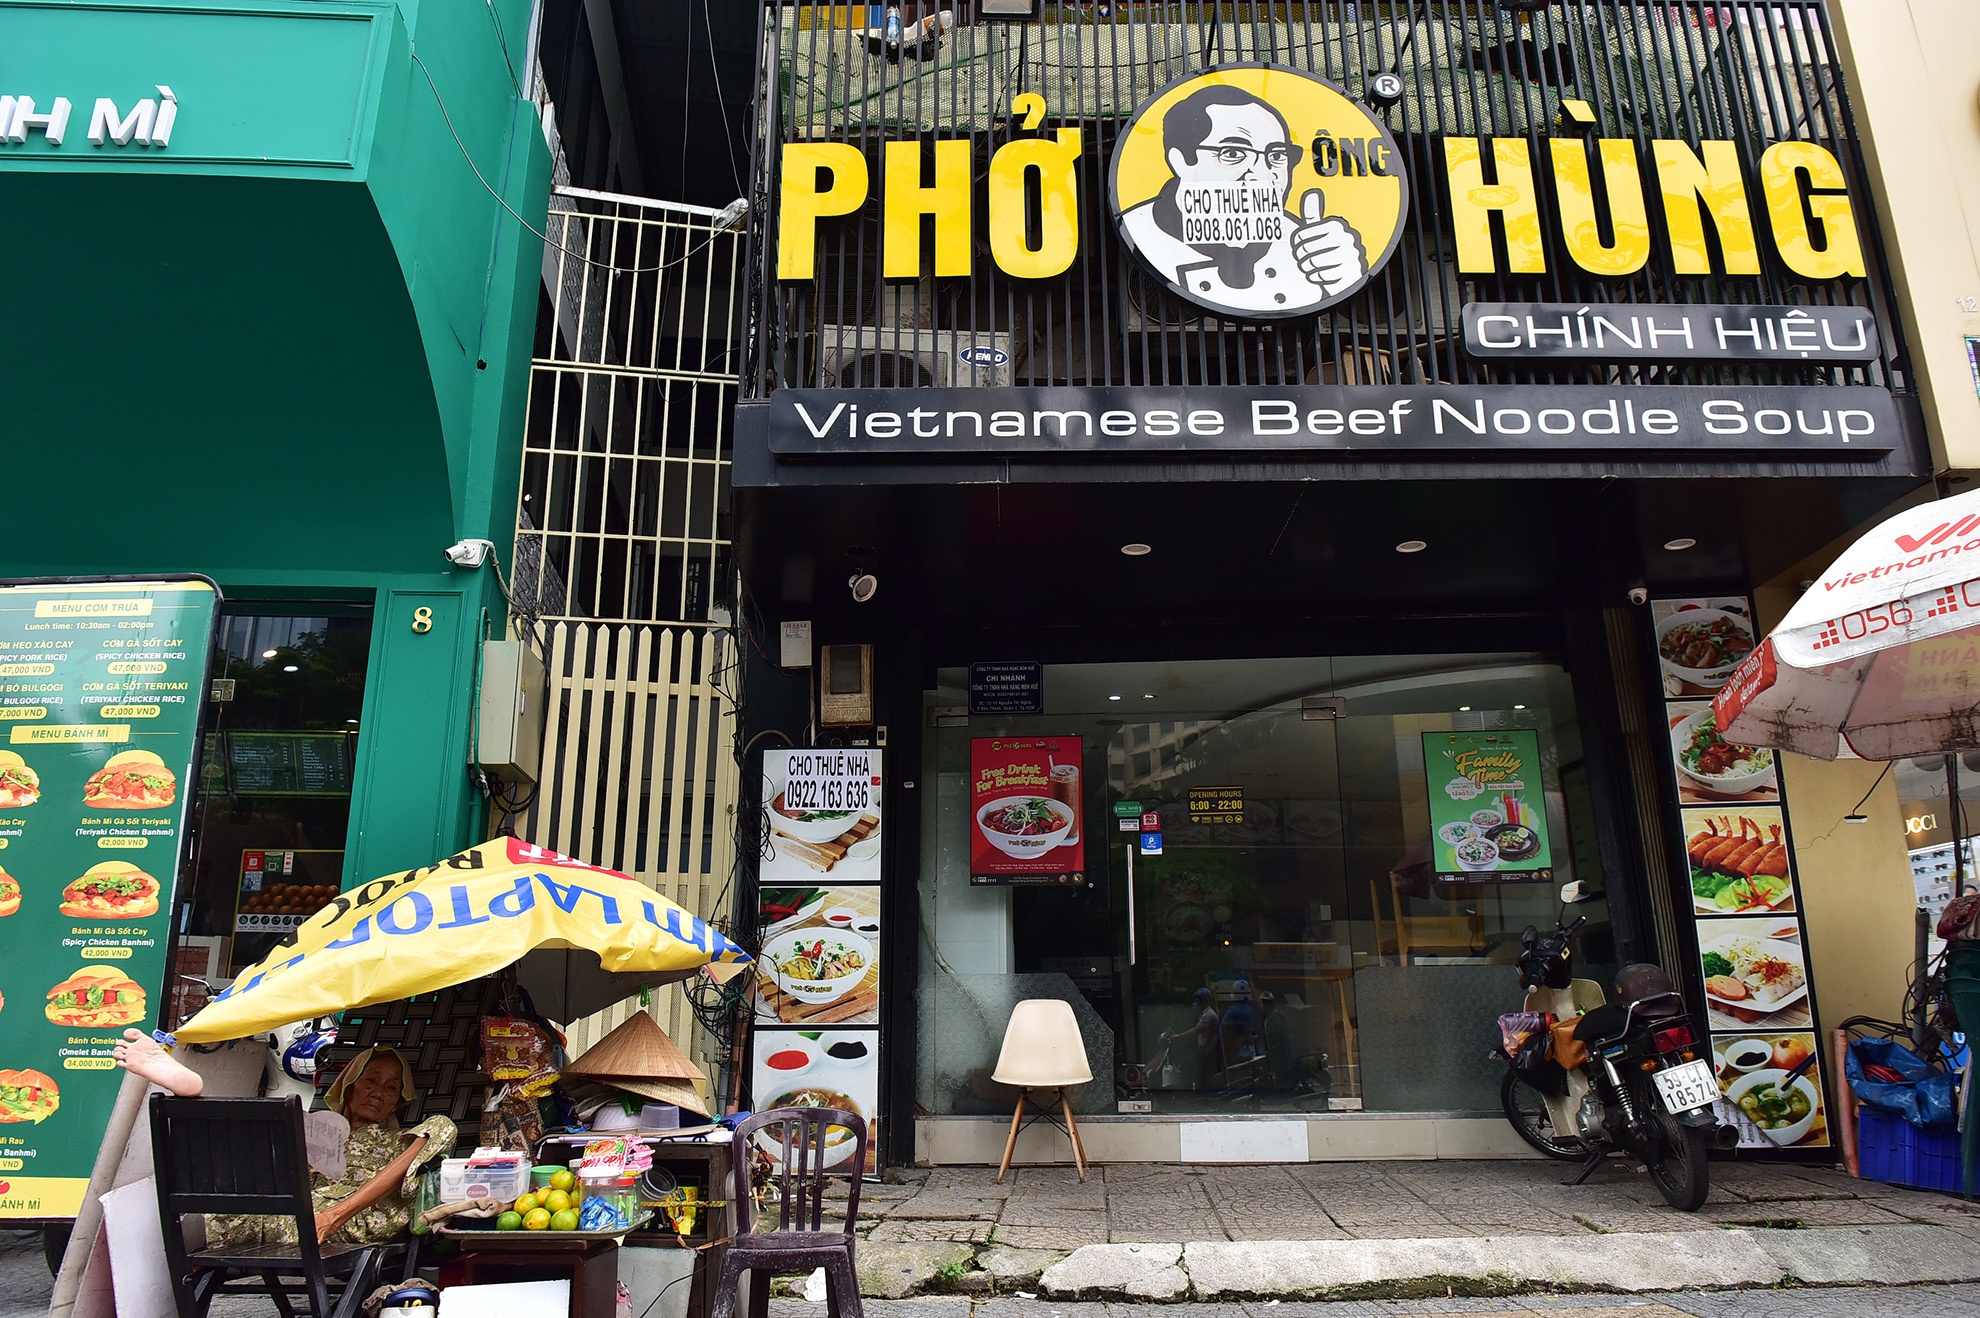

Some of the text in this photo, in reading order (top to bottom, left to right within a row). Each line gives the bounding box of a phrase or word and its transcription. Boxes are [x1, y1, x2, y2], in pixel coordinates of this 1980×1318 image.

[87, 84, 178, 147] MÌ
[777, 92, 1867, 279] PHỞ ÔNG HÙNG
[1184, 179, 1281, 214] CHO THUÊ NHÀ
[1185, 216, 1283, 242] 0908.061.068
[1478, 306, 1867, 358] CHÍNH HIỆU
[793, 399, 1876, 443] Vietnamese Beef Noodle Soup
[52, 603, 138, 613] MENU CƠM TRƯA
[412, 606, 433, 633] 8
[1841, 599, 1913, 640] 056
[25, 622, 50, 630] Lunch
[52, 622, 73, 630] time:
[118, 622, 154, 630] 02:00pm
[13, 641, 32, 649] HEO
[34, 640, 53, 649] XÀO
[103, 636, 182, 647] CƠM GÀ SỐT CAY
[45, 654, 67, 662] RICE)
[124, 652, 161, 660] CHICKEN
[163, 652, 186, 660] RICE)
[2, 666, 30, 674] 47,000
[113, 664, 164, 672] 47,000 VND
[1000, 673, 1026, 681] NHÁNH
[6, 683, 19, 692] BÒ
[82, 680, 188, 690] CƠM GÀ SỐT TERIYAKI
[80, 696, 122, 704] (TERIYAKI
[164, 696, 186, 704] RICE)
[104, 707, 156, 716] 47,000 VND
[31, 727, 109, 738] MENU BÁNH MÌ
[789, 751, 870, 776] CHO THUÊ NHÀ
[1455, 750, 1522, 776] Family
[982, 764, 1041, 780] Free Drink
[1467, 768, 1506, 789] Time
[976, 780, 993, 794] For
[996, 774, 1049, 787] Breakfast
[788, 780, 868, 808] 0922.163 636
[1190, 801, 1209, 810] 6:00
[1218, 800, 1243, 810] 22:00
[12, 818, 26, 826] Cay
[141, 818, 171, 826] Teriyaki
[75, 829, 107, 837] (Teriyaki
[141, 829, 174, 837] Banhmi)
[133, 928, 147, 936] Cay
[62, 938, 154, 947] (Spicy Chicken Banhmi)
[59, 1048, 89, 1056] (Omelet
[68, 1060, 92, 1068] 34,000
[1666, 1081, 1717, 1110] 185.74
[4, 1149, 36, 1158] Banhmi)
[28, 1198, 41, 1210] MÌ
